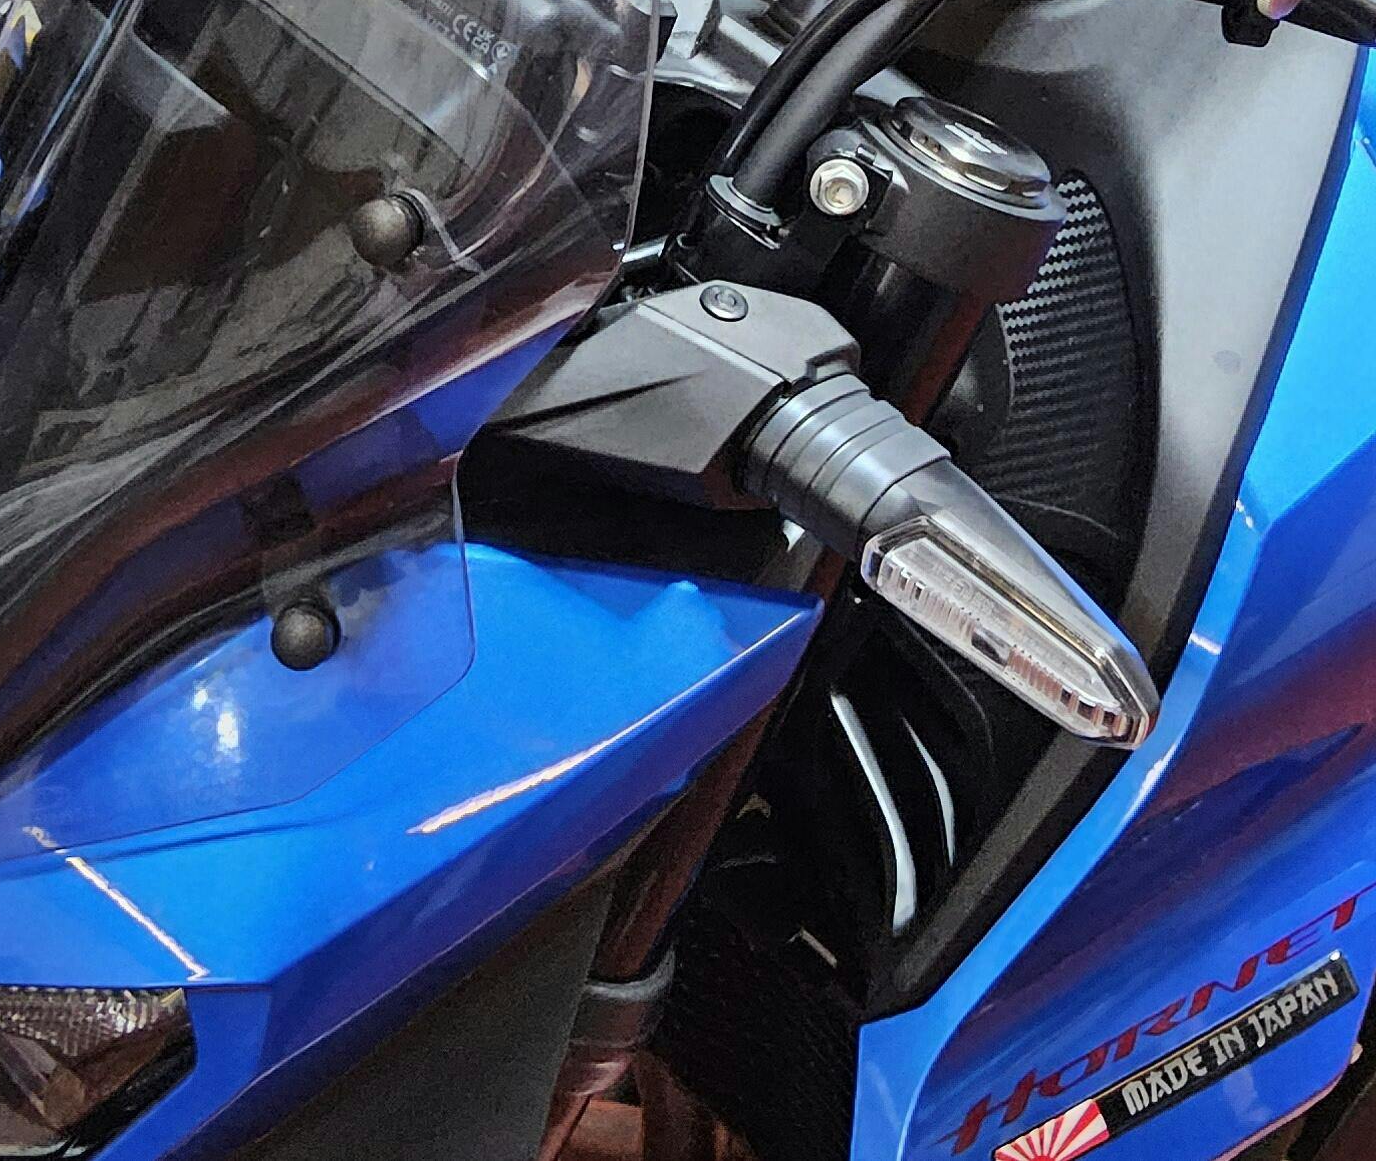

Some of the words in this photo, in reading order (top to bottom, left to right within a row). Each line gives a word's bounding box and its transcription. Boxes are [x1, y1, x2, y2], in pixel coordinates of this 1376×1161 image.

[1121, 1050, 1208, 1116] MADE
[1213, 1023, 1246, 1066] IN
[1255, 969, 1341, 1049] JAPAN
